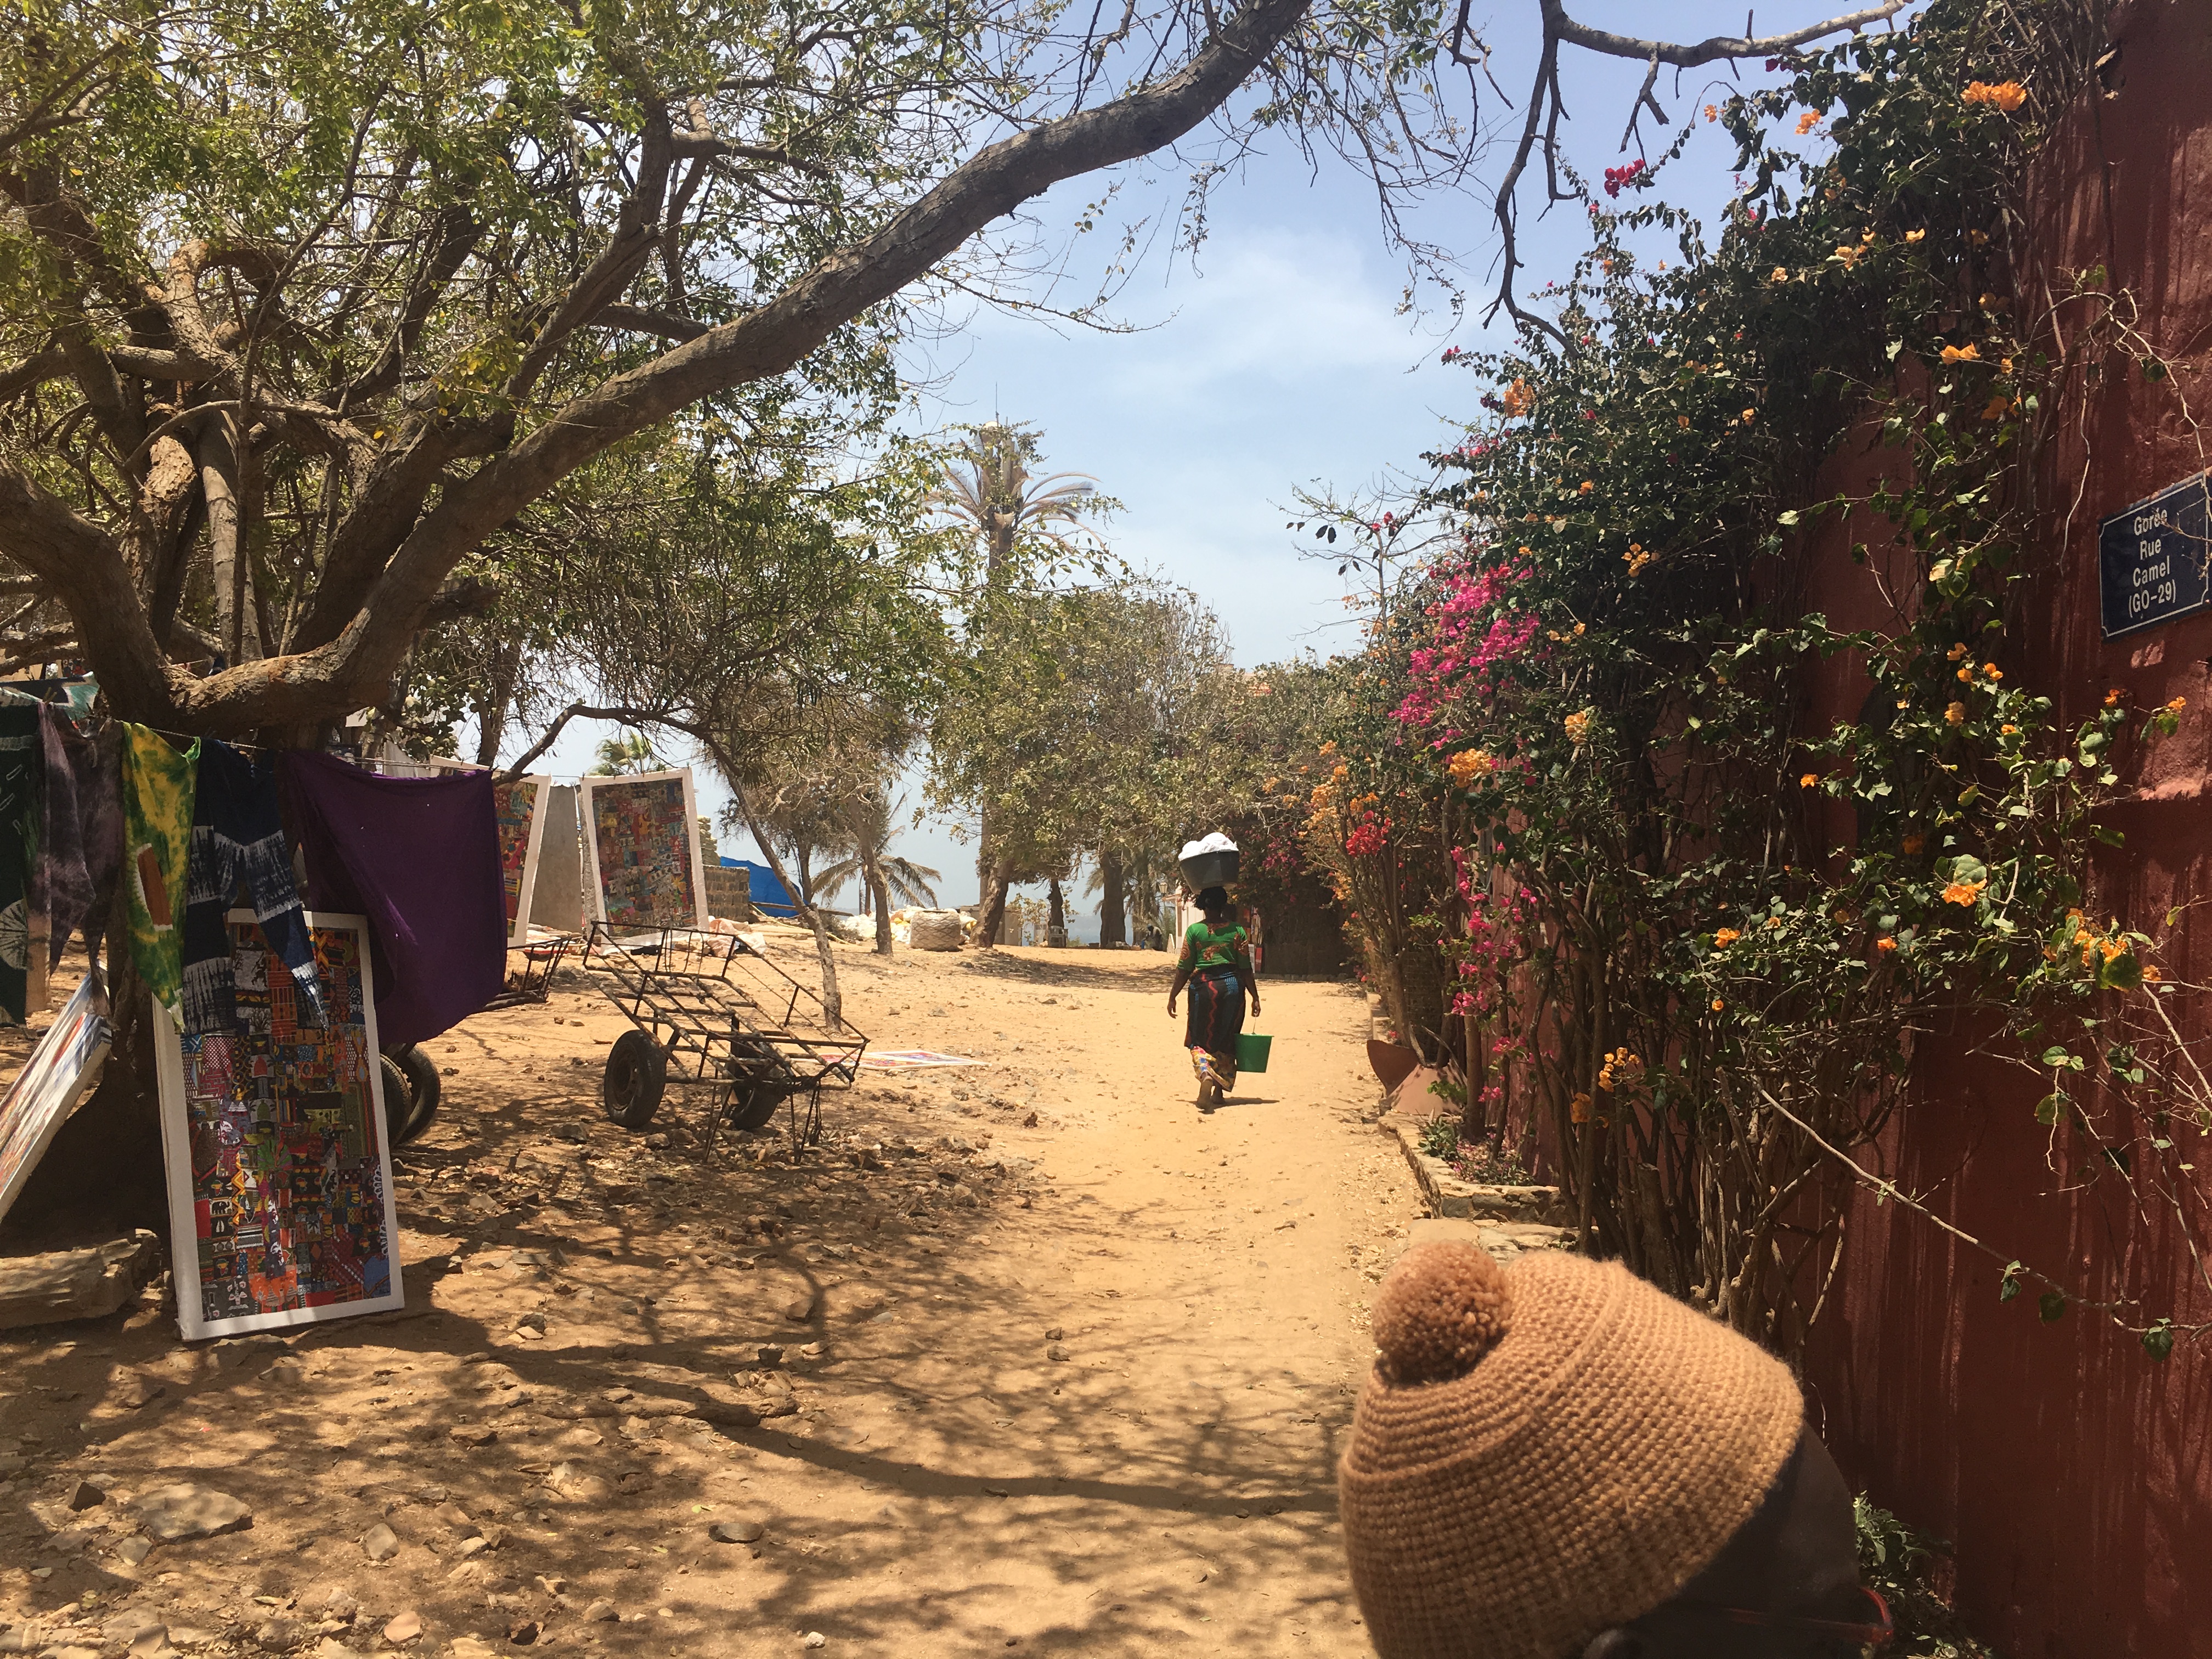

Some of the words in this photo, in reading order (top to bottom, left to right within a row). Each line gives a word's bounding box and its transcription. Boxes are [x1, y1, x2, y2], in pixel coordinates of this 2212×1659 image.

[2134, 507, 2167, 535] Gorée
[2140, 539, 2162, 560] Rue
[2133, 555, 2170, 587] Camel
[2129, 579, 2176, 618] (GO-29)
